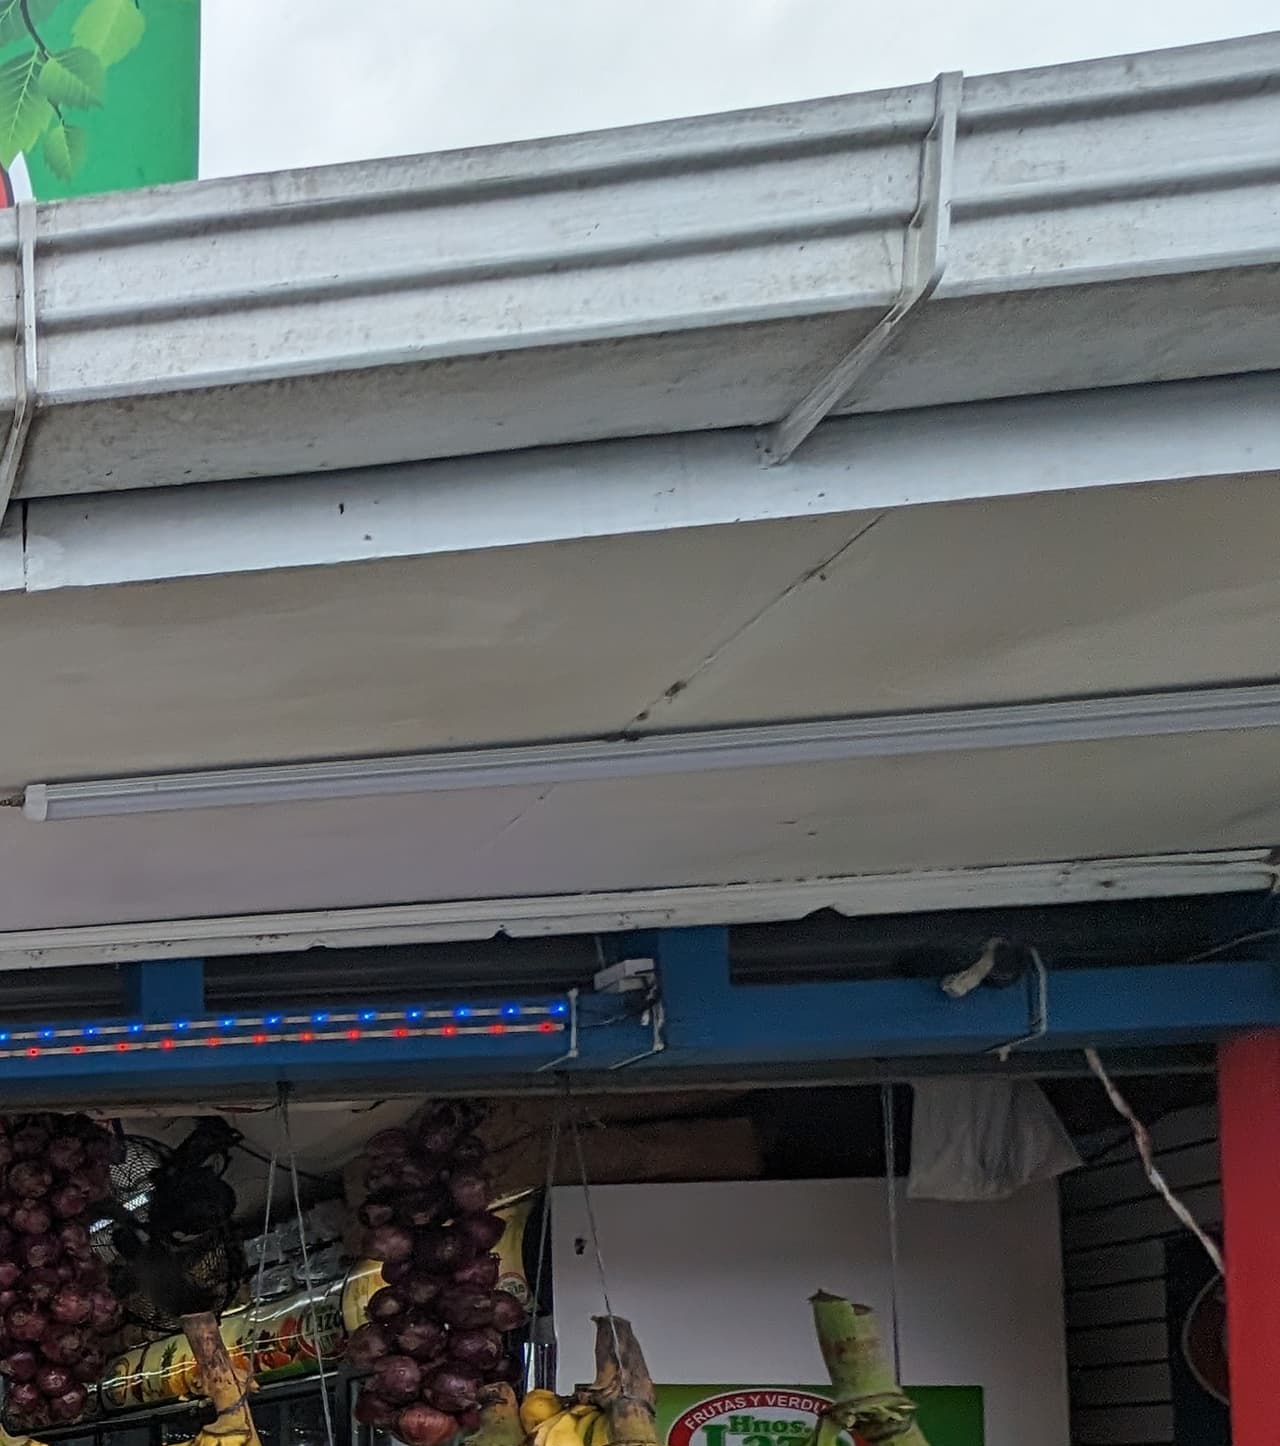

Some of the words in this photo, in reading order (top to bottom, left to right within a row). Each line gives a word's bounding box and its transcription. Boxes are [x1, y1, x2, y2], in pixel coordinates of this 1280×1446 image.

[685, 1397, 746, 1431] FRUTAS
[750, 1394, 761, 1407] Y
[729, 1414, 812, 1434] Hnos.
